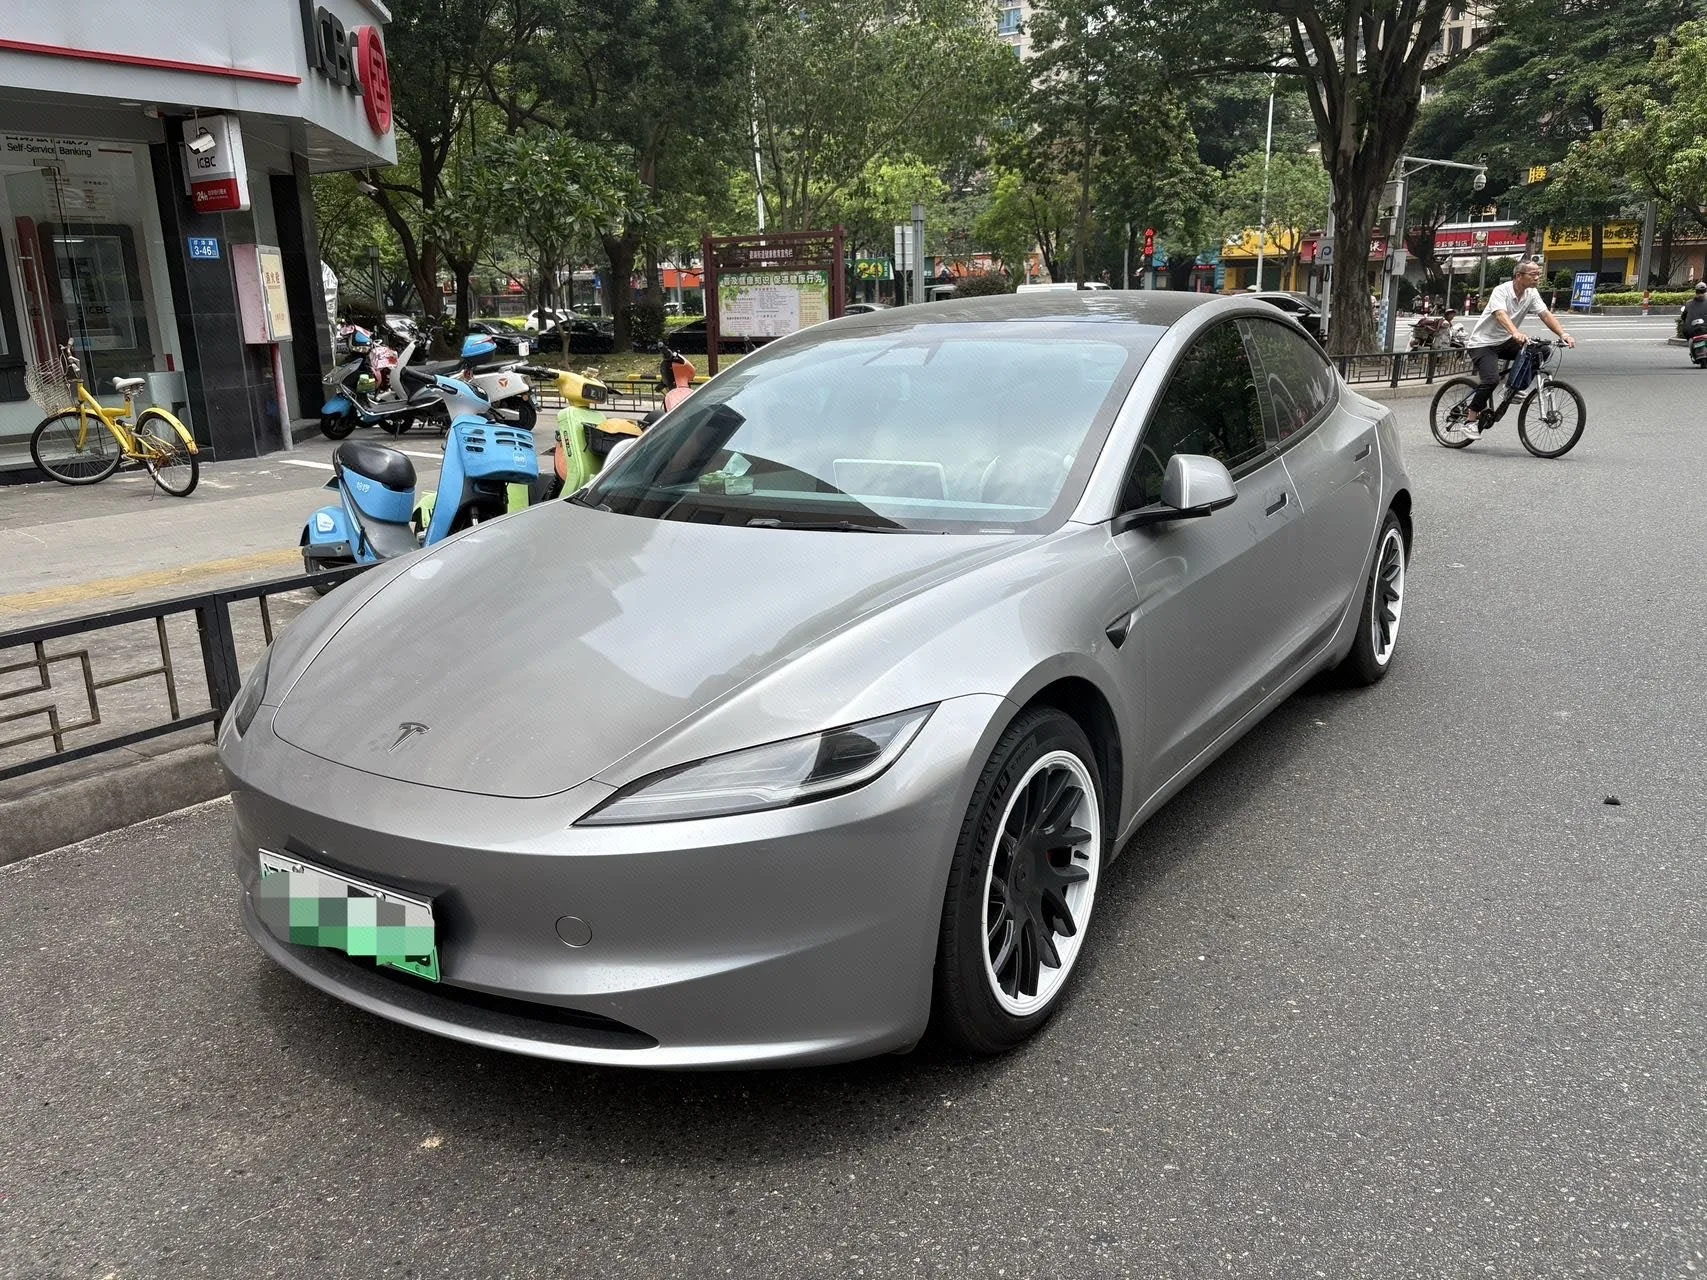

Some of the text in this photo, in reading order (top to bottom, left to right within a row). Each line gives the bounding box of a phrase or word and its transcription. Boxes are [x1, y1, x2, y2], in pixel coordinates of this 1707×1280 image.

[299, 0, 365, 96] ICBC
[7, 143, 92, 158] Self-Service Banking
[196, 156, 216, 169] ICBC
[194, 246, 211, 256] 3-46
[85, 305, 112, 315] ICBC
